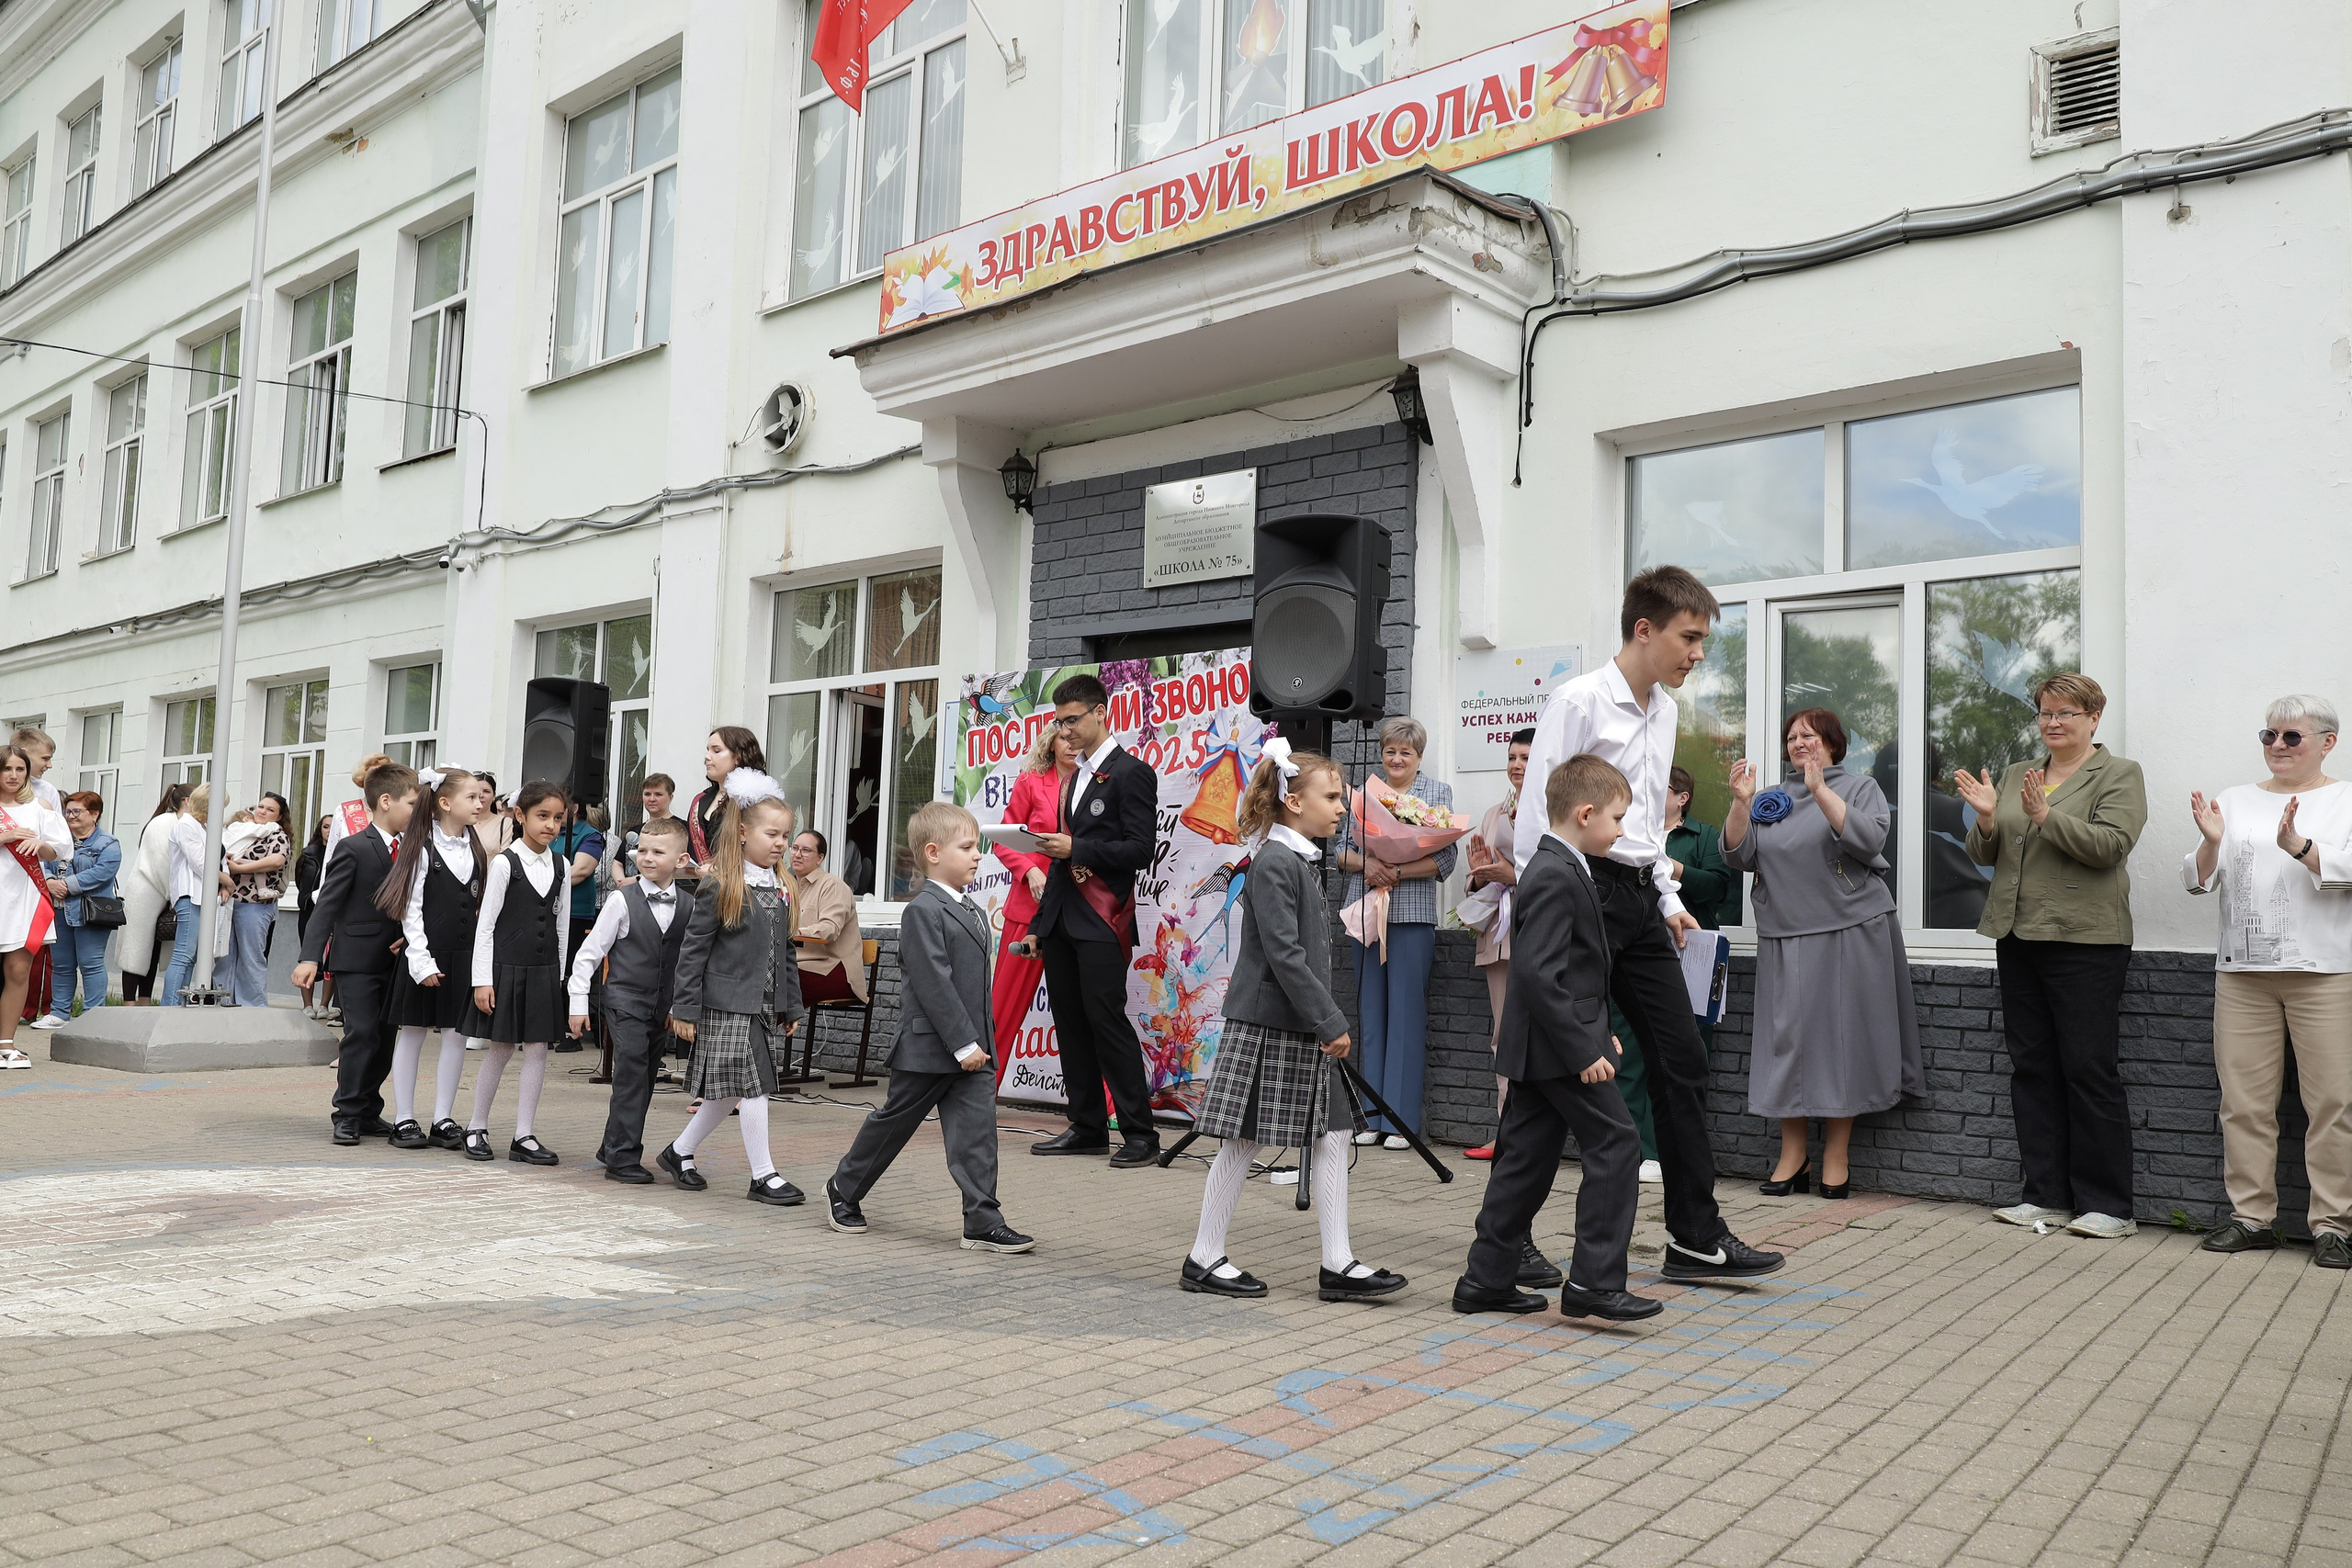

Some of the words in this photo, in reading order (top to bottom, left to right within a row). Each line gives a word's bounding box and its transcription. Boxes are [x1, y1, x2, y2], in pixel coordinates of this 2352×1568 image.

[976, 152, 1265, 291] ЗДРАВСТВУЙ,
[1285, 64, 1535, 191] ШКОЛА!
[1155, 528, 1204, 542] МУНИЦИПАЛЬНОЕ
[1204, 524, 1243, 535] БЮДЖЕТНОЕ
[1164, 533, 1232, 547] ОБЩЕОБРАЗОВАТЕЛЬНОЕ
[1178, 542, 1216, 553] УЧРЕЖДЕНИЕ
[1154, 558, 1205, 577] «ШКОЛА
[1208, 557, 1223, 570] №
[1226, 554, 1243, 568] 75»
[1151, 660, 1252, 724] ЗВОНО
[1461, 694, 1534, 710] ФЕДЕРАЛЬНЫЙ
[1462, 714, 1503, 727] УСПЕХ
